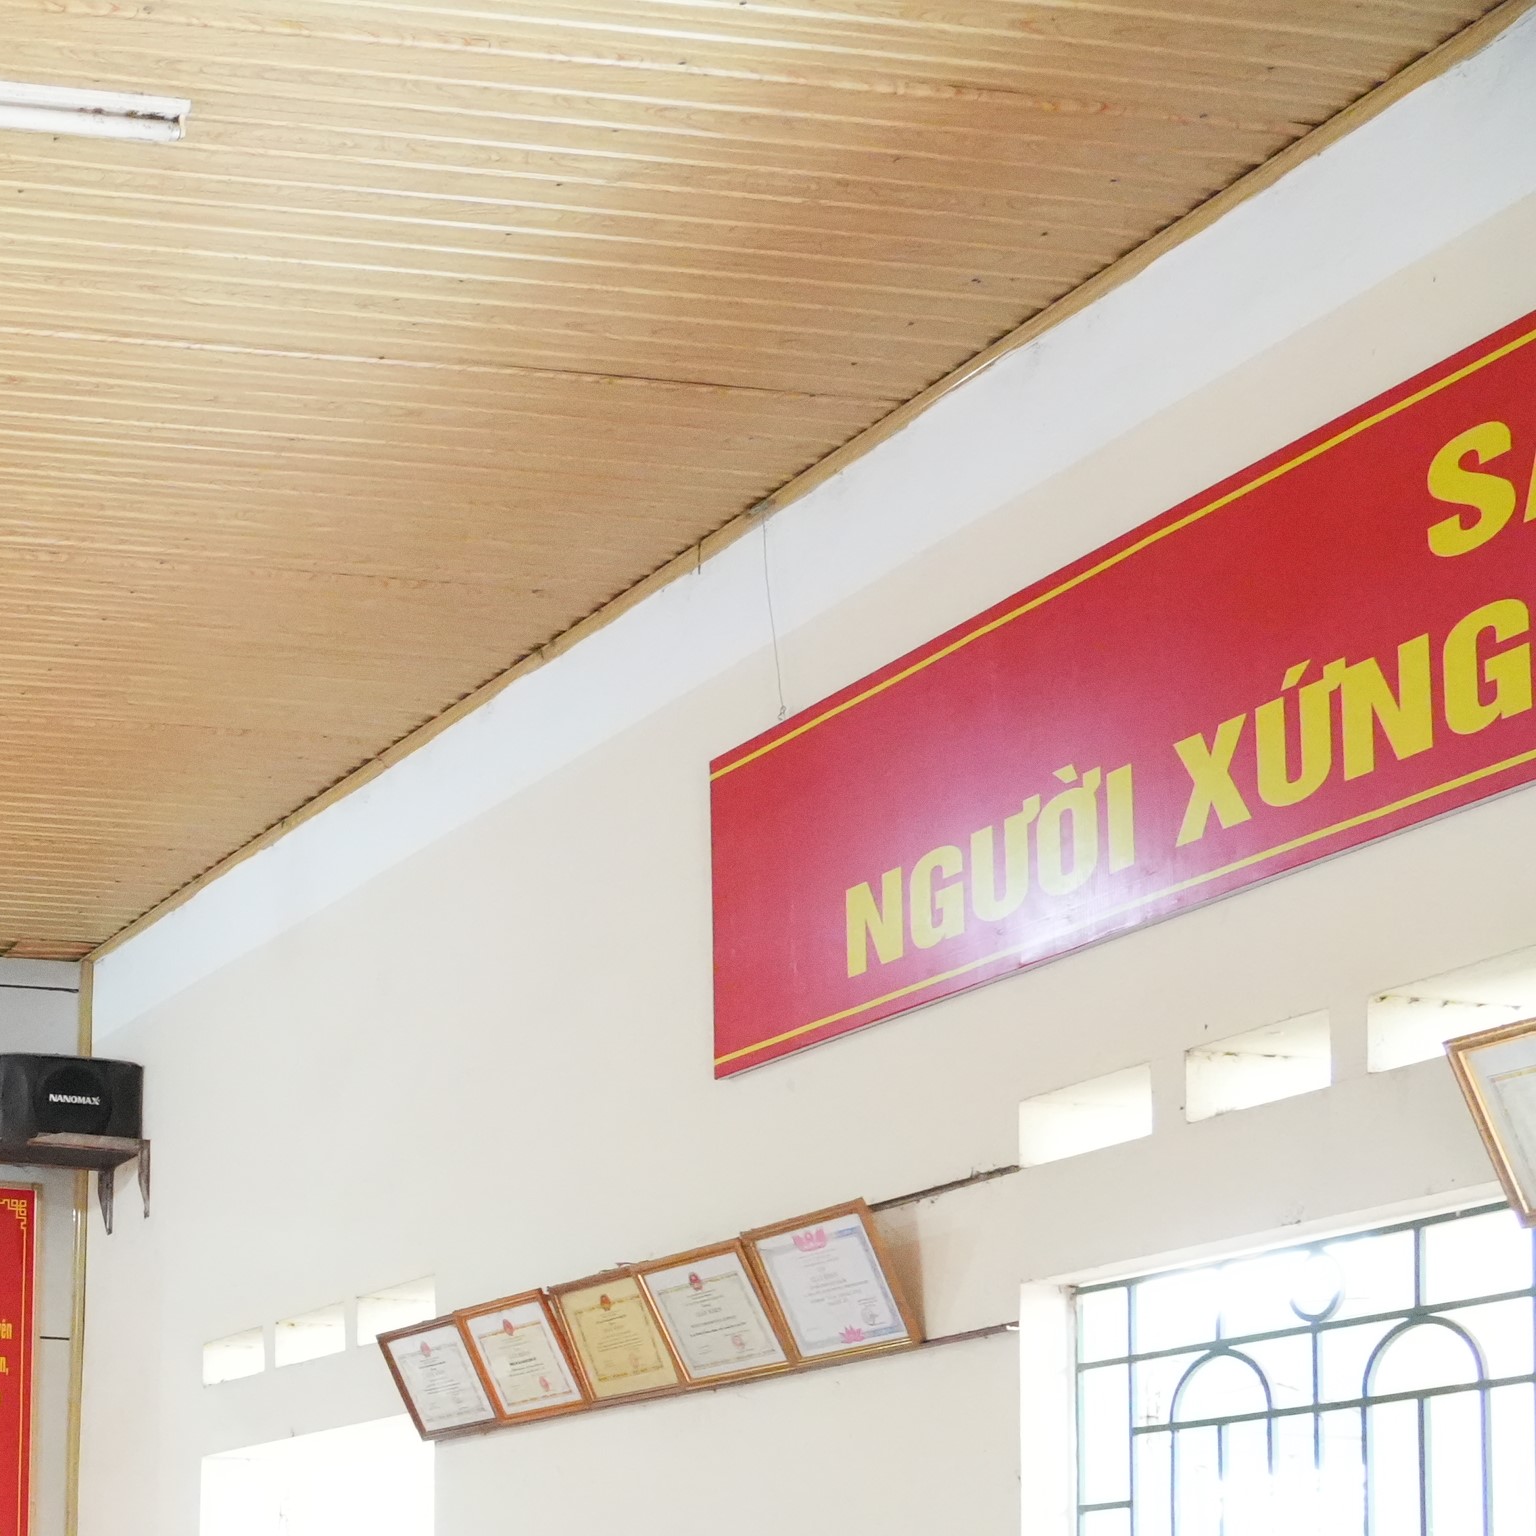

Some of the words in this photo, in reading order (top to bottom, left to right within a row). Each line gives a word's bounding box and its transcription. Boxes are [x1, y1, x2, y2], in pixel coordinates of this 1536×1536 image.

[1427, 421, 1536, 557] S
[845, 764, 1135, 978] NGƯỜI
[1174, 598, 1534, 848] XỨNG
[49, 1093, 101, 1106] NANOMAX
